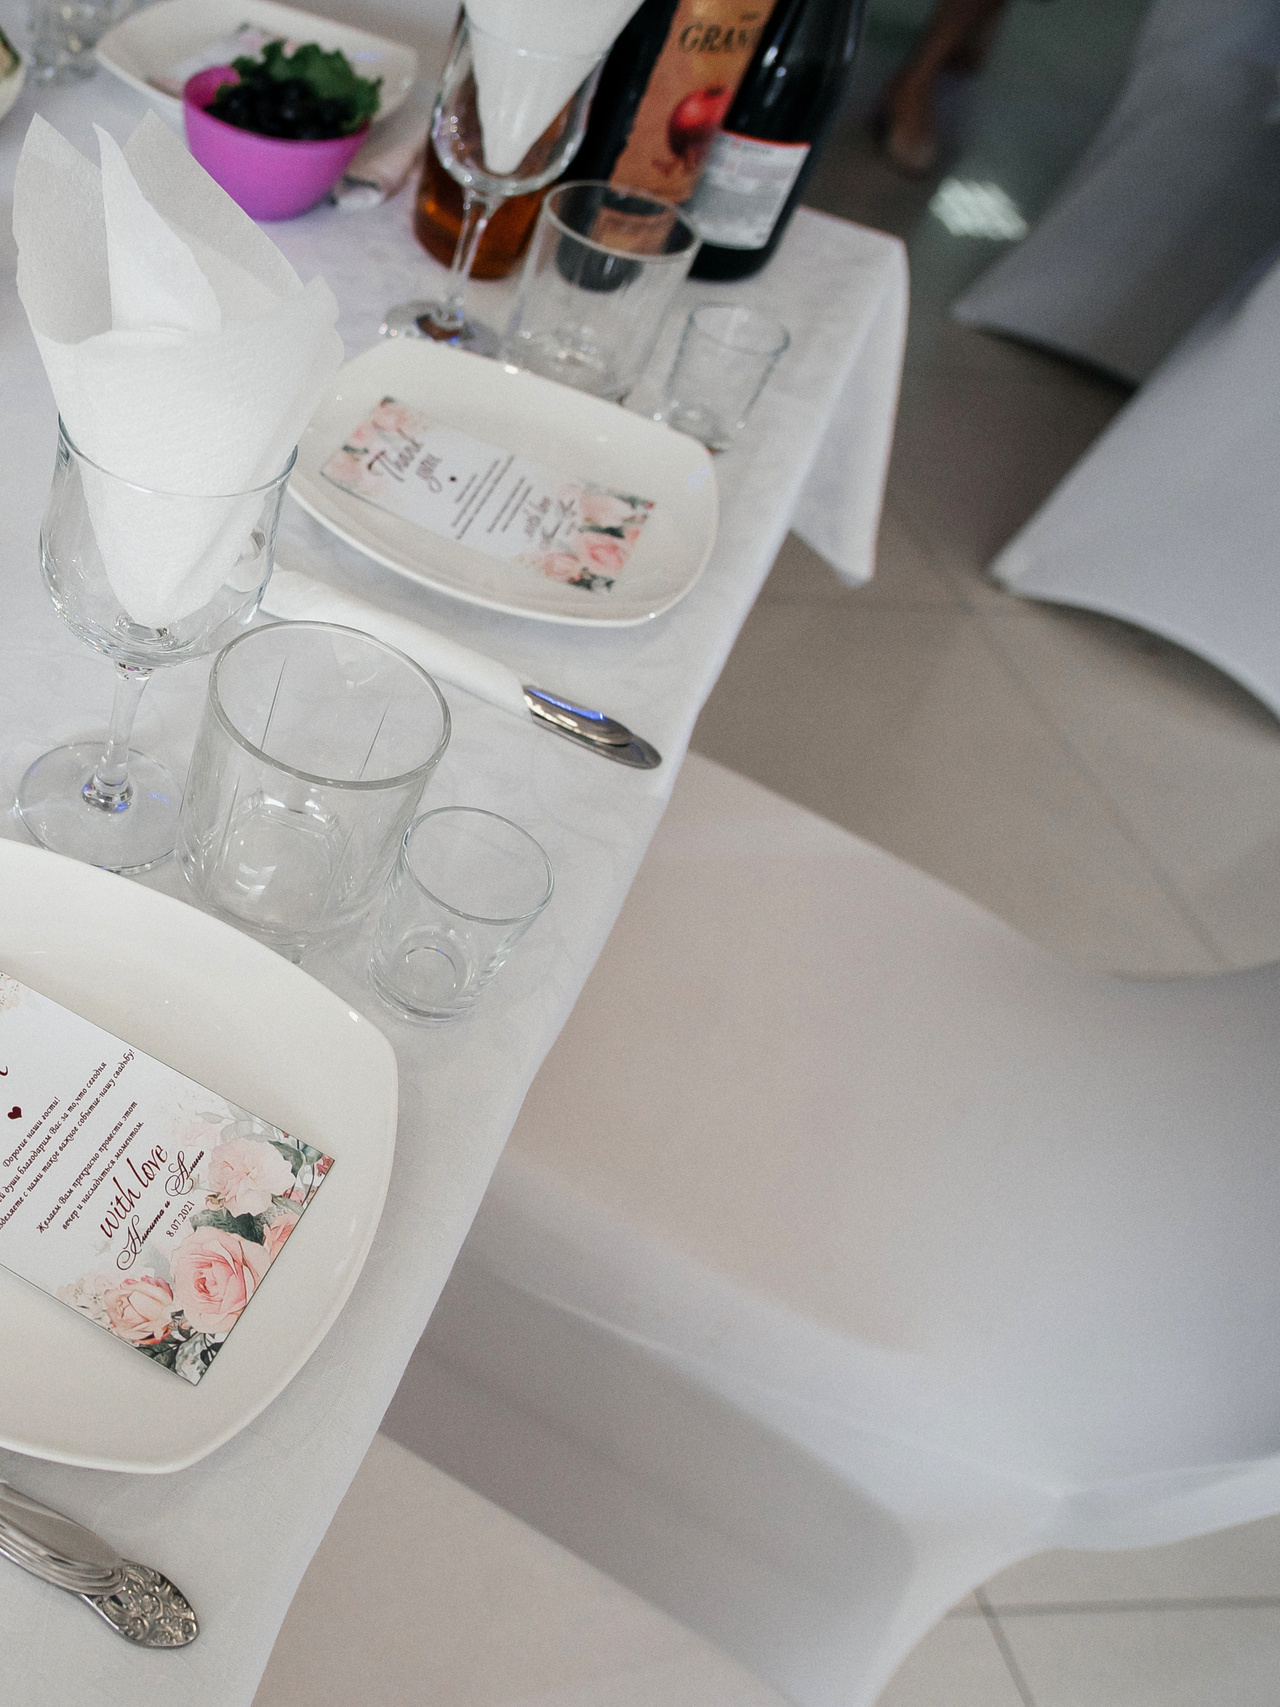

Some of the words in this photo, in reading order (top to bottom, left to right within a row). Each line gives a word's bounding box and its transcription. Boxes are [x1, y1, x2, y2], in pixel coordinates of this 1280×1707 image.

[367, 427, 423, 482] Thank
[2, 1175, 20, 1193] души
[17, 1135, 52, 1174] благодарим
[49, 1121, 62, 1134] Вас
[61, 1113, 69, 1121] за
[86, 1062, 107, 1088] сегодня
[3, 1139, 28, 1167] Дорогие
[27, 1120, 43, 1139] наши
[42, 1096, 60, 1120] гости!
[27, 1173, 43, 1192] нами
[42, 1151, 59, 1173] такое
[59, 1126, 78, 1151] важное
[113, 1049, 134, 1078] свадьбу!
[36, 1205, 61, 1233] Желаем
[58, 1188, 74, 1204] Вам
[72, 1153, 99, 1188] прекрасно
[98, 1121, 123, 1153] провести
[122, 1102, 137, 1121] этот
[63, 1210, 79, 1230] вечер
[81, 1159, 116, 1204] насладиться
[115, 1122, 144, 1160] моментом.
[100, 1176, 141, 1238] with
[126, 1145, 167, 1188] love
[165, 1151, 204, 1197] Алина
[116, 1209, 164, 1270] Никита
[164, 1200, 171, 1209] и
[166, 1201, 195, 1237] 8.07.2021
